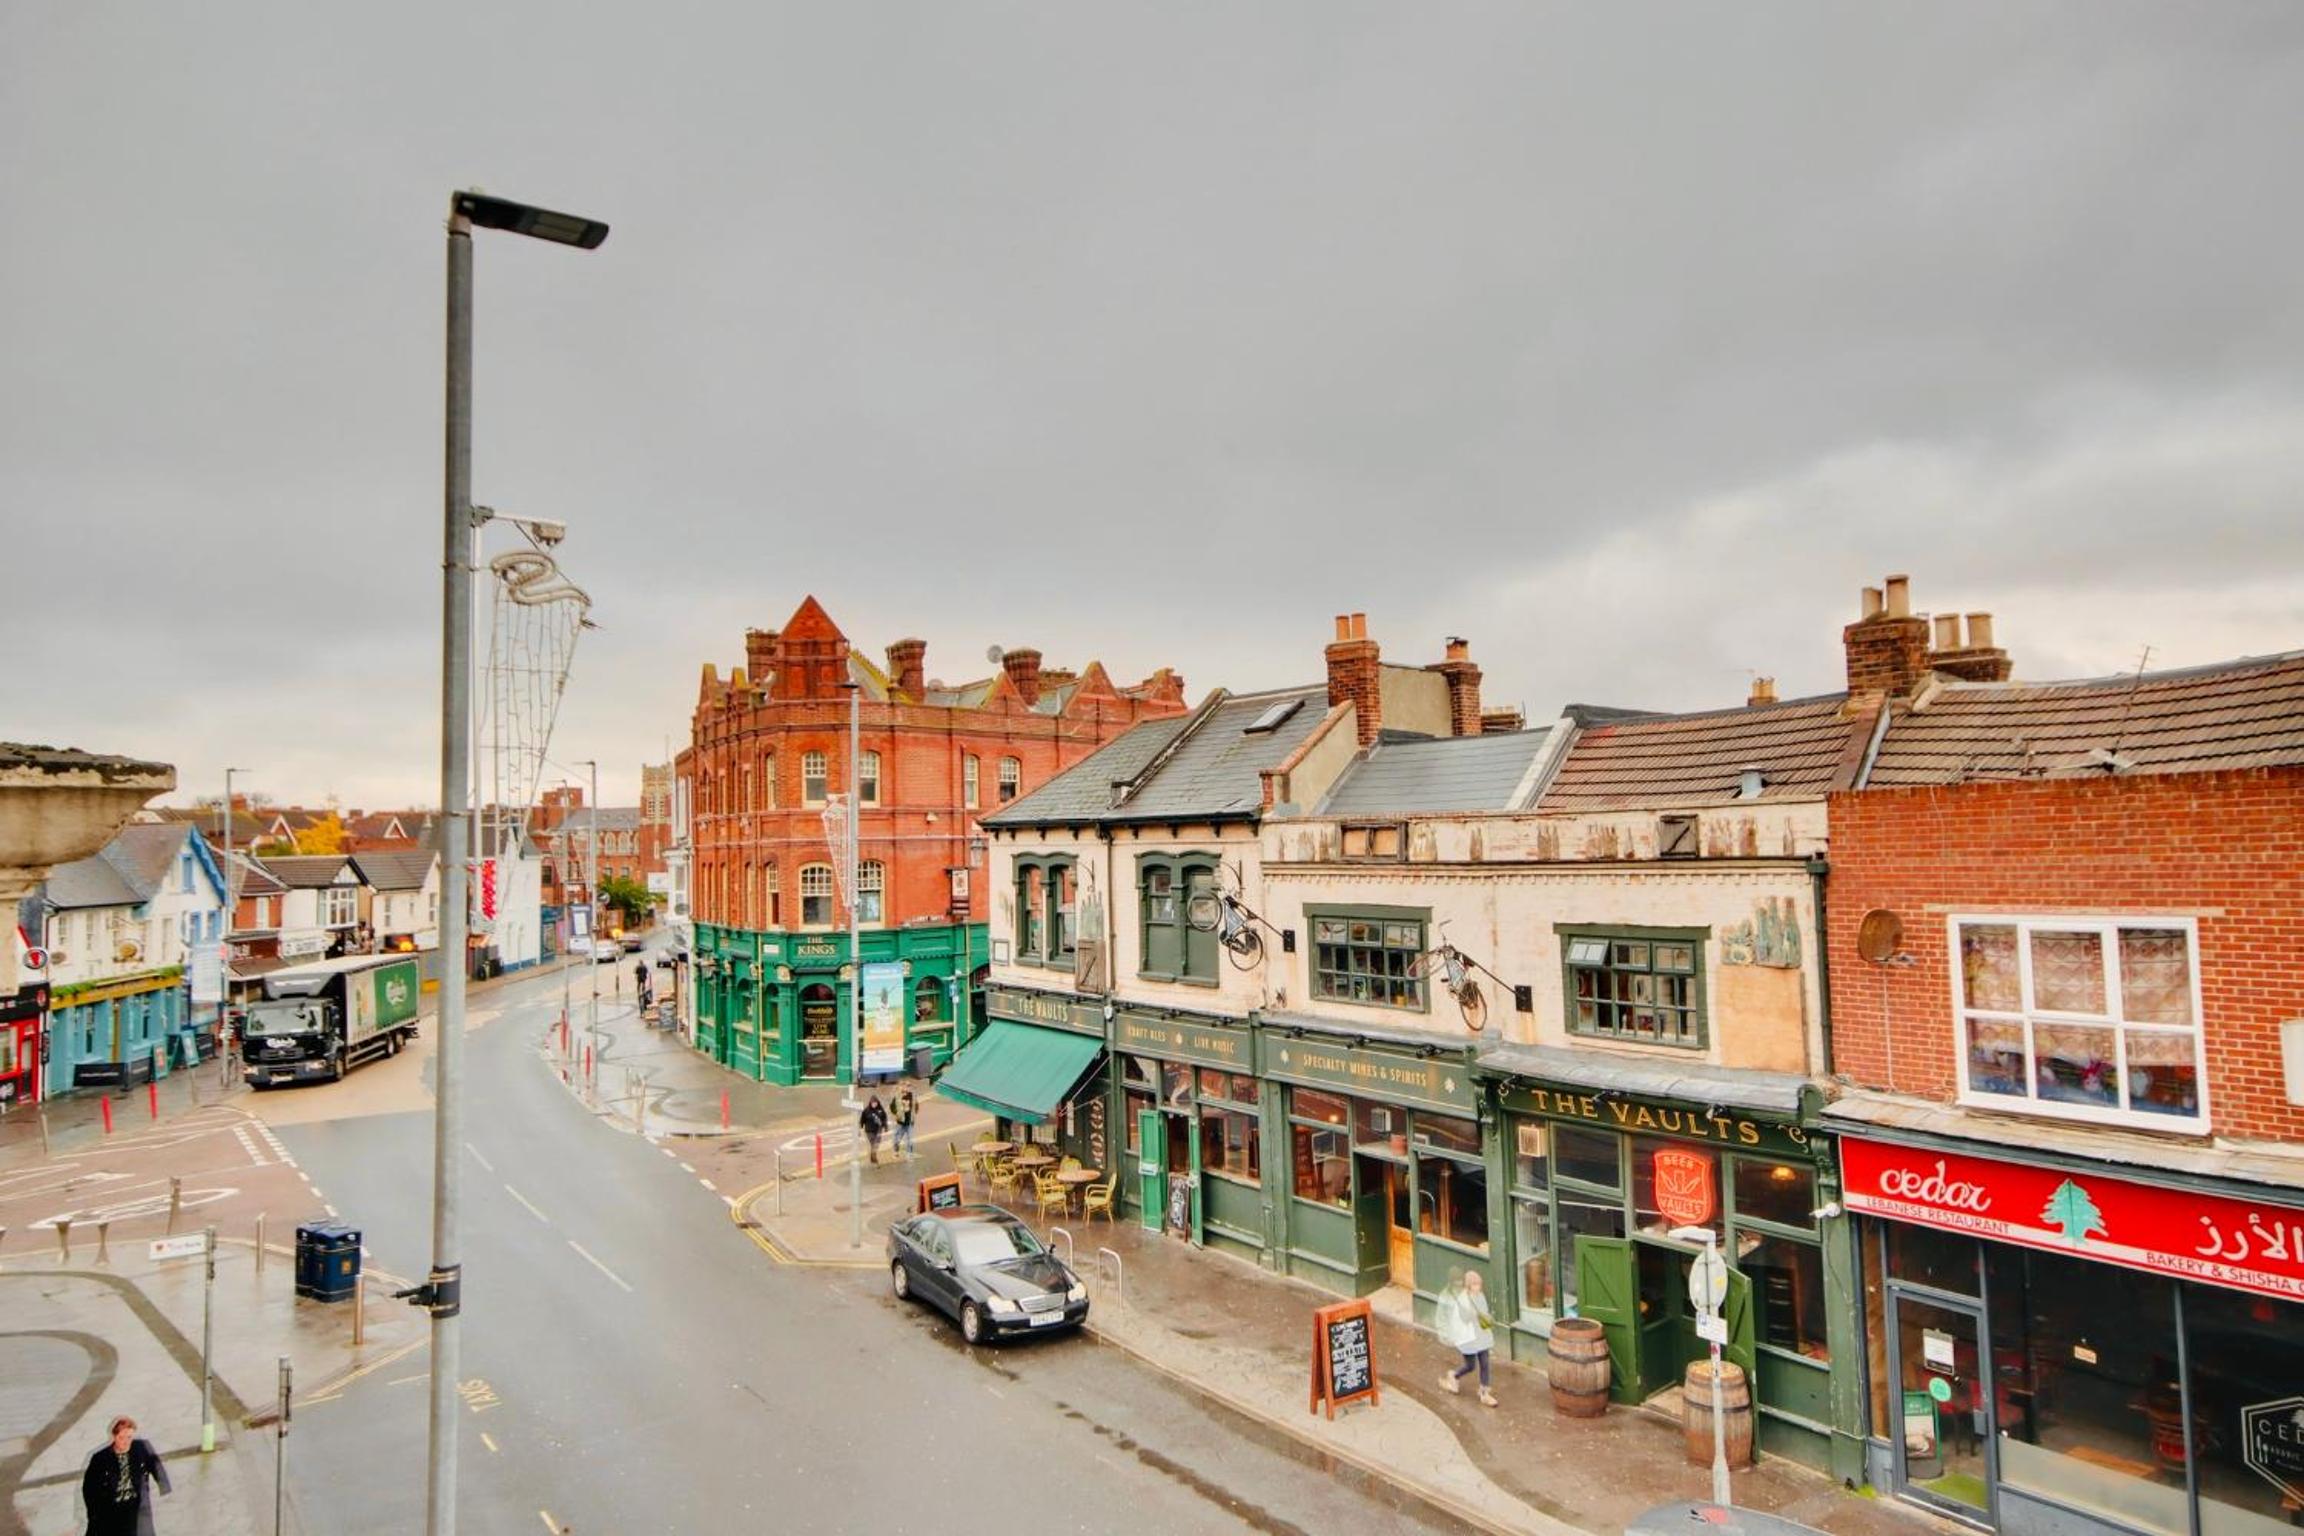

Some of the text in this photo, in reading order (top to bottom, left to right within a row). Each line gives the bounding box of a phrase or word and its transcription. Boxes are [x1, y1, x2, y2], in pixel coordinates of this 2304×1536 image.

[797, 943, 836, 955] KINGS
[1019, 998, 1068, 1022] THE VAULTS
[1303, 1053, 1427, 1087] SPECIALTY WINES & SPIRITS
[1531, 1089, 1761, 1145] THE VAULTS
[1663, 1155, 1695, 1170] BEER
[1879, 1158, 1992, 1212] cedar
[1659, 1197, 1705, 1215] VAULTS
[1866, 1197, 2012, 1235] LEBANESE RESTAURANT
[2194, 1212, 2304, 1264] الأرز
[2146, 1251, 2205, 1274] BAKERY
[2211, 1265, 2222, 1278] &
[2229, 1267, 2293, 1291] SHISHA
